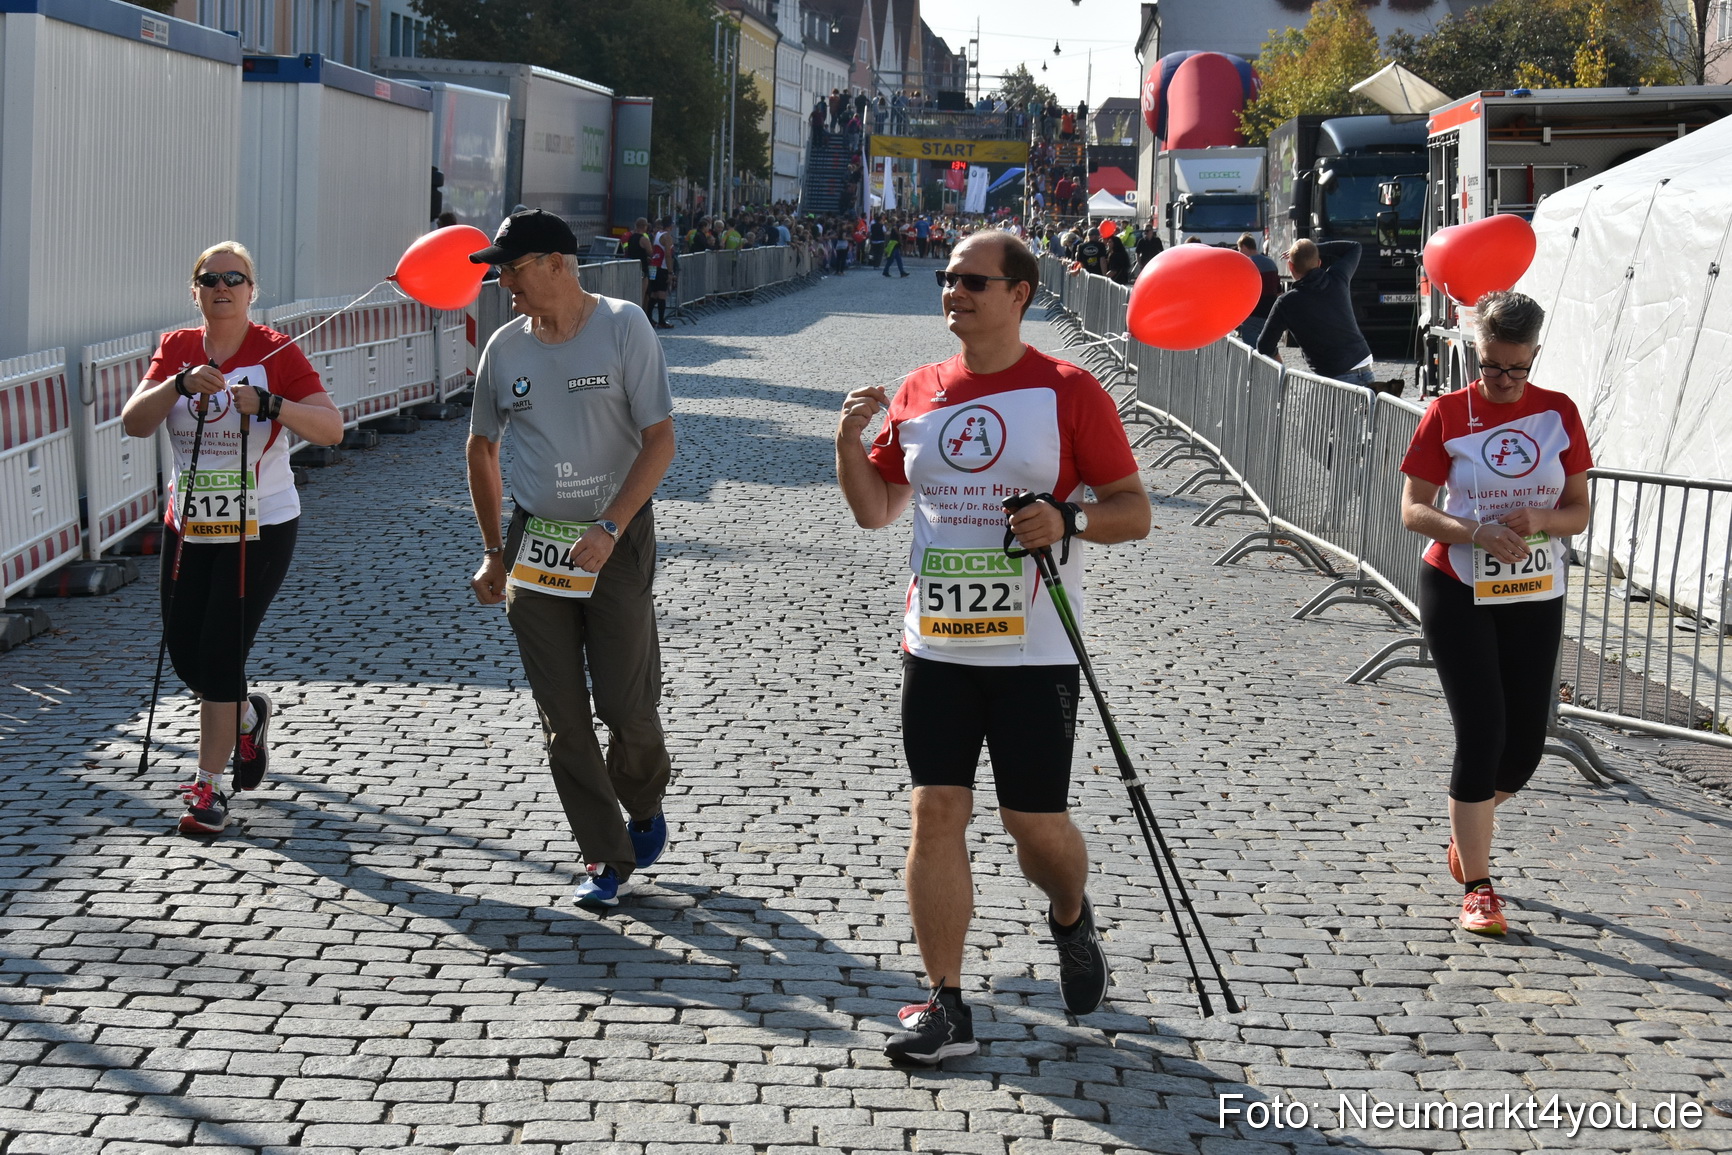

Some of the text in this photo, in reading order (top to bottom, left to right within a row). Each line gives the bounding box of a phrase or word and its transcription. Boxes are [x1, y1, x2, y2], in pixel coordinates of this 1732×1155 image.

[921, 143, 976, 157] START
[1199, 171, 1241, 179] BOCK
[567, 375, 608, 389] BOCK
[512, 400, 532, 408] PARTL
[223, 430, 242, 439] HER
[554, 462, 578, 478] 19.
[555, 474, 607, 488] Neumarkter
[556, 486, 600, 499] Stadtlauf
[921, 484, 957, 496] LAUFEN
[963, 486, 986, 496] MIT
[1467, 484, 1560, 500] LAUFEN MIT HERZ
[939, 502, 958, 510] Heck
[966, 503, 980, 511] Dr.
[1489, 501, 1509, 510] Heck
[929, 515, 1007, 527] Leistungsdiagnosti
[529, 516, 588, 541] BOC
[925, 550, 1015, 574] BOCK
[538, 574, 572, 588] KARL
[1491, 580, 1543, 595] CARMEN
[928, 583, 1011, 612] 5122
[932, 621, 1009, 635] ANDREAS
